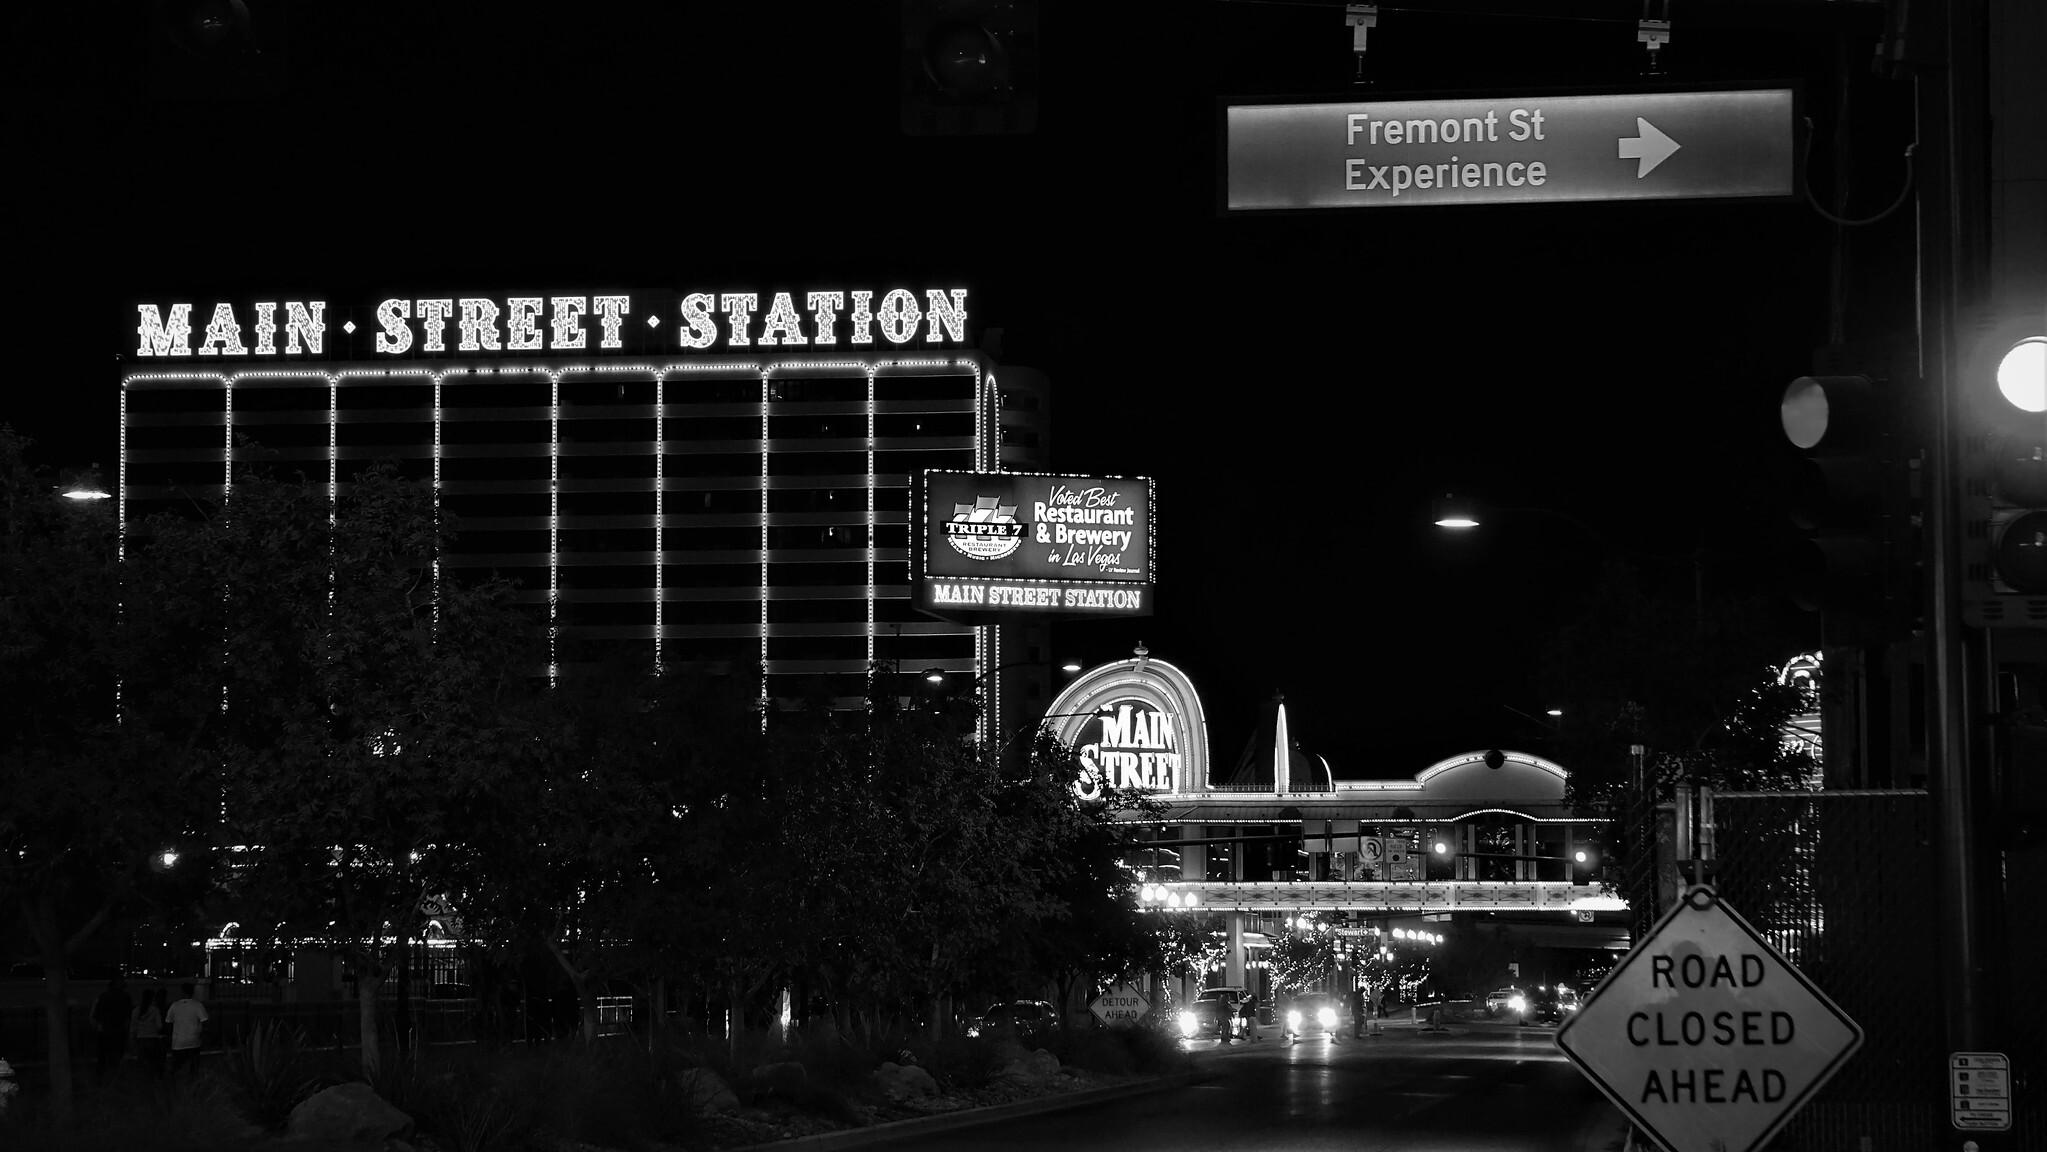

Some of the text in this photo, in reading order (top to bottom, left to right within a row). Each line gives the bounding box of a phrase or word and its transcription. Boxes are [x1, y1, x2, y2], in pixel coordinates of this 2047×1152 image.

[1347, 108, 1545, 145] Fremont St
[1345, 155, 1547, 197] Experience
[136, 288, 967, 356] MAIN STREET STATION
[1049, 485, 1120, 508] Voted Best
[1034, 501, 1134, 525] Restaurant
[945, 522, 1023, 536] TRIPLE 7
[1036, 522, 1132, 552] & Brewery
[1048, 543, 1121, 572] in Las Vegas
[934, 584, 1141, 609] MAIN STREET STATION
[1098, 704, 1174, 749] MAIN
[1072, 742, 1181, 801] STREET
[1337, 928, 1364, 937] Stewart
[1652, 954, 1765, 988] ROAD
[1102, 997, 1139, 1007] DETOUR
[1105, 1010, 1138, 1019] AHEAD
[1627, 1011, 1795, 1047] CLOSED
[1641, 1069, 1787, 1104] AHEAD
